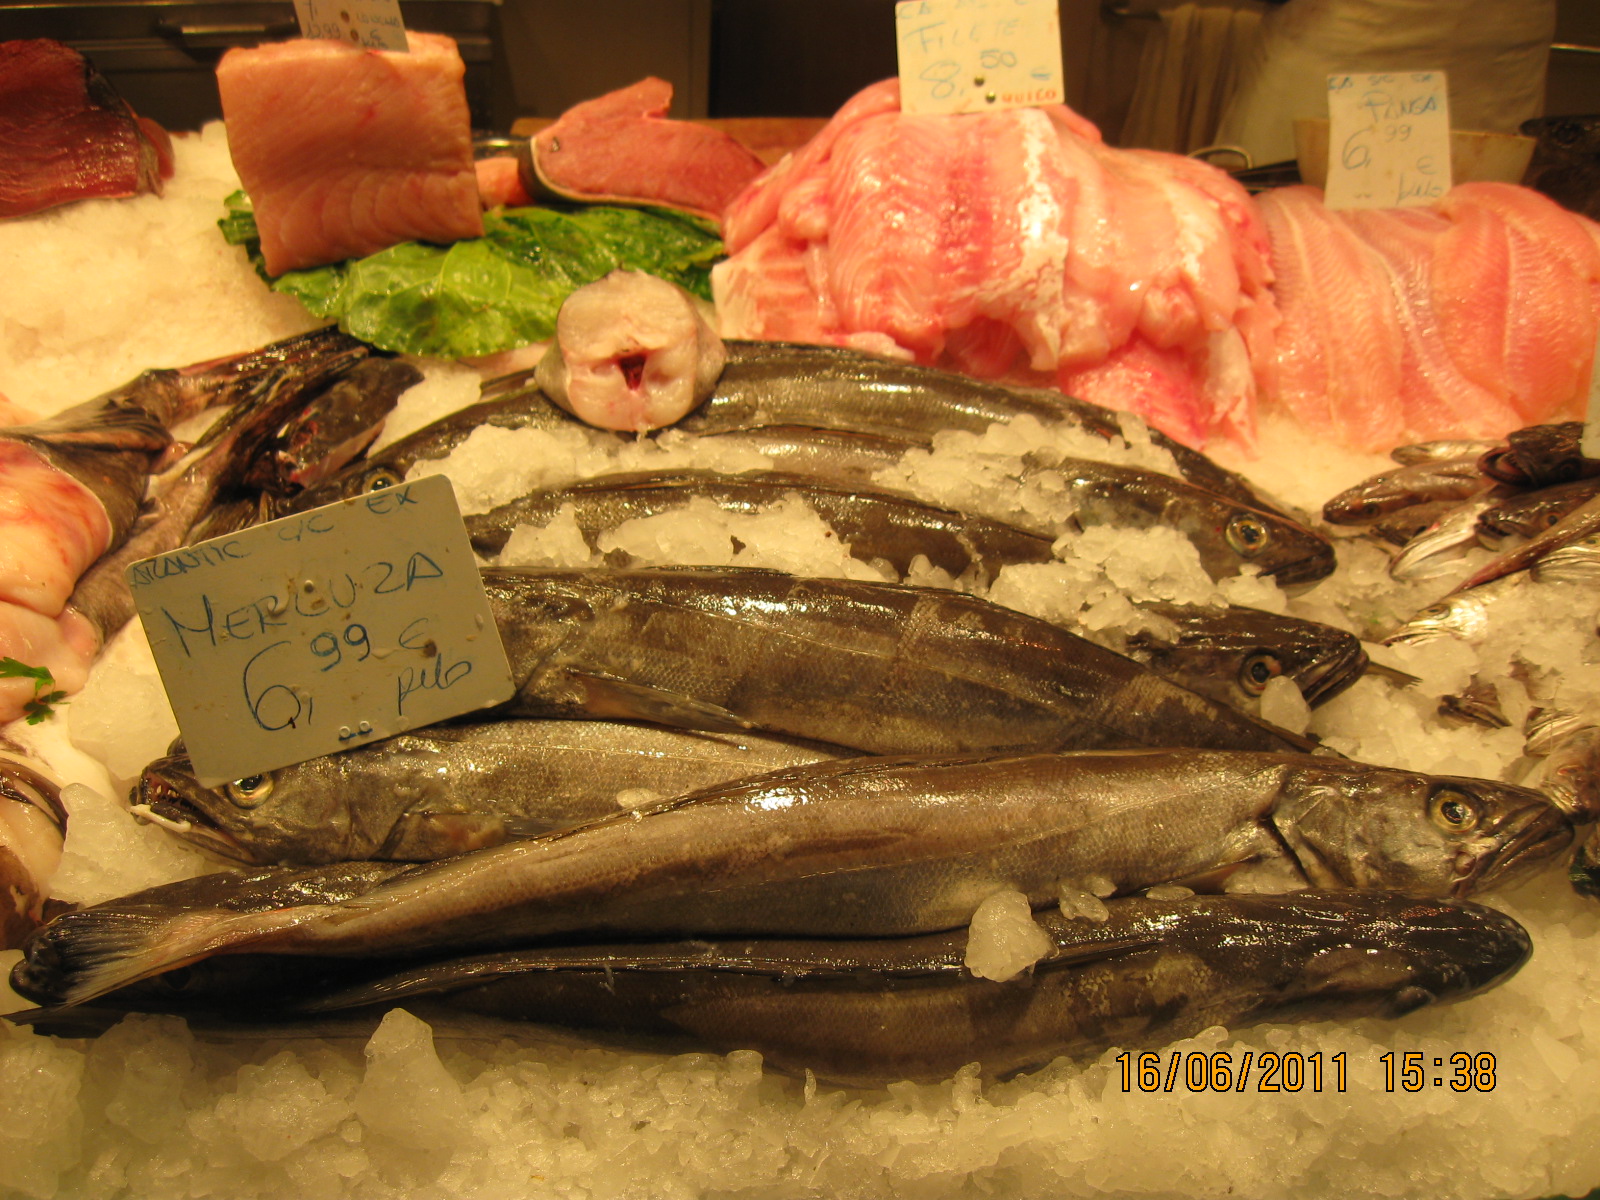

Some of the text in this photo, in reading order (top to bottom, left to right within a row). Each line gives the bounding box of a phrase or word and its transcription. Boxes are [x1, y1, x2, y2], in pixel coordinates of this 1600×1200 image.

[1362, 89, 1438, 123] PANGA
[1416, 154, 1438, 176] €
[398, 617, 430, 650] €
